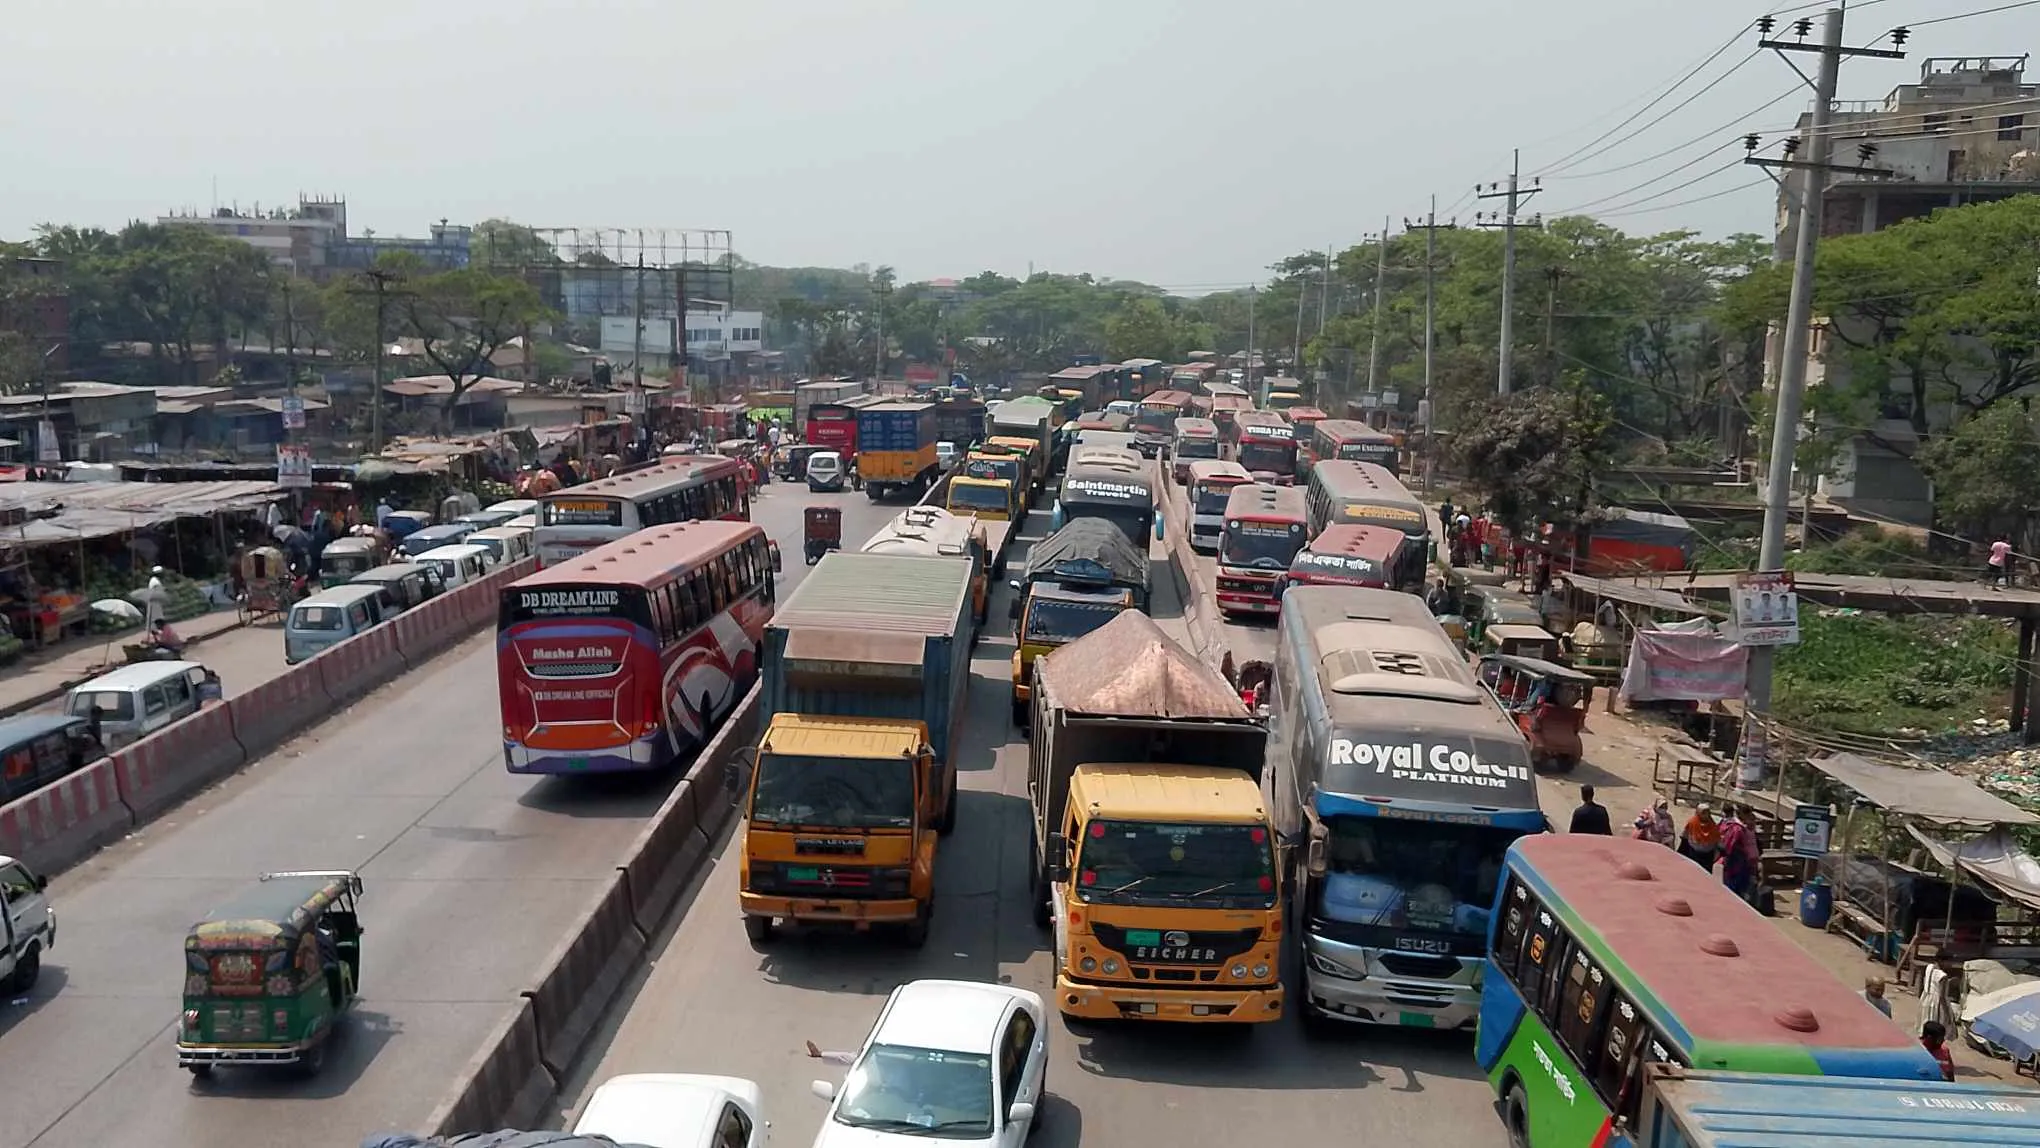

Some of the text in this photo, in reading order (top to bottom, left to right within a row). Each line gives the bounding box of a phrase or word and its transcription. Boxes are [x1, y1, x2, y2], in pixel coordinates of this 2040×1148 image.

[1067, 479, 1147, 496] Saintmartin
[521, 590, 619, 608] DB DREAM LINE
[532, 646, 612, 660] Masha Allah
[1330, 739, 1422, 773] Royal
[1392, 769, 1507, 788] PLATINUM
[1136, 947, 1216, 960] EICHER
[1395, 937, 1450, 953] ISUZU
